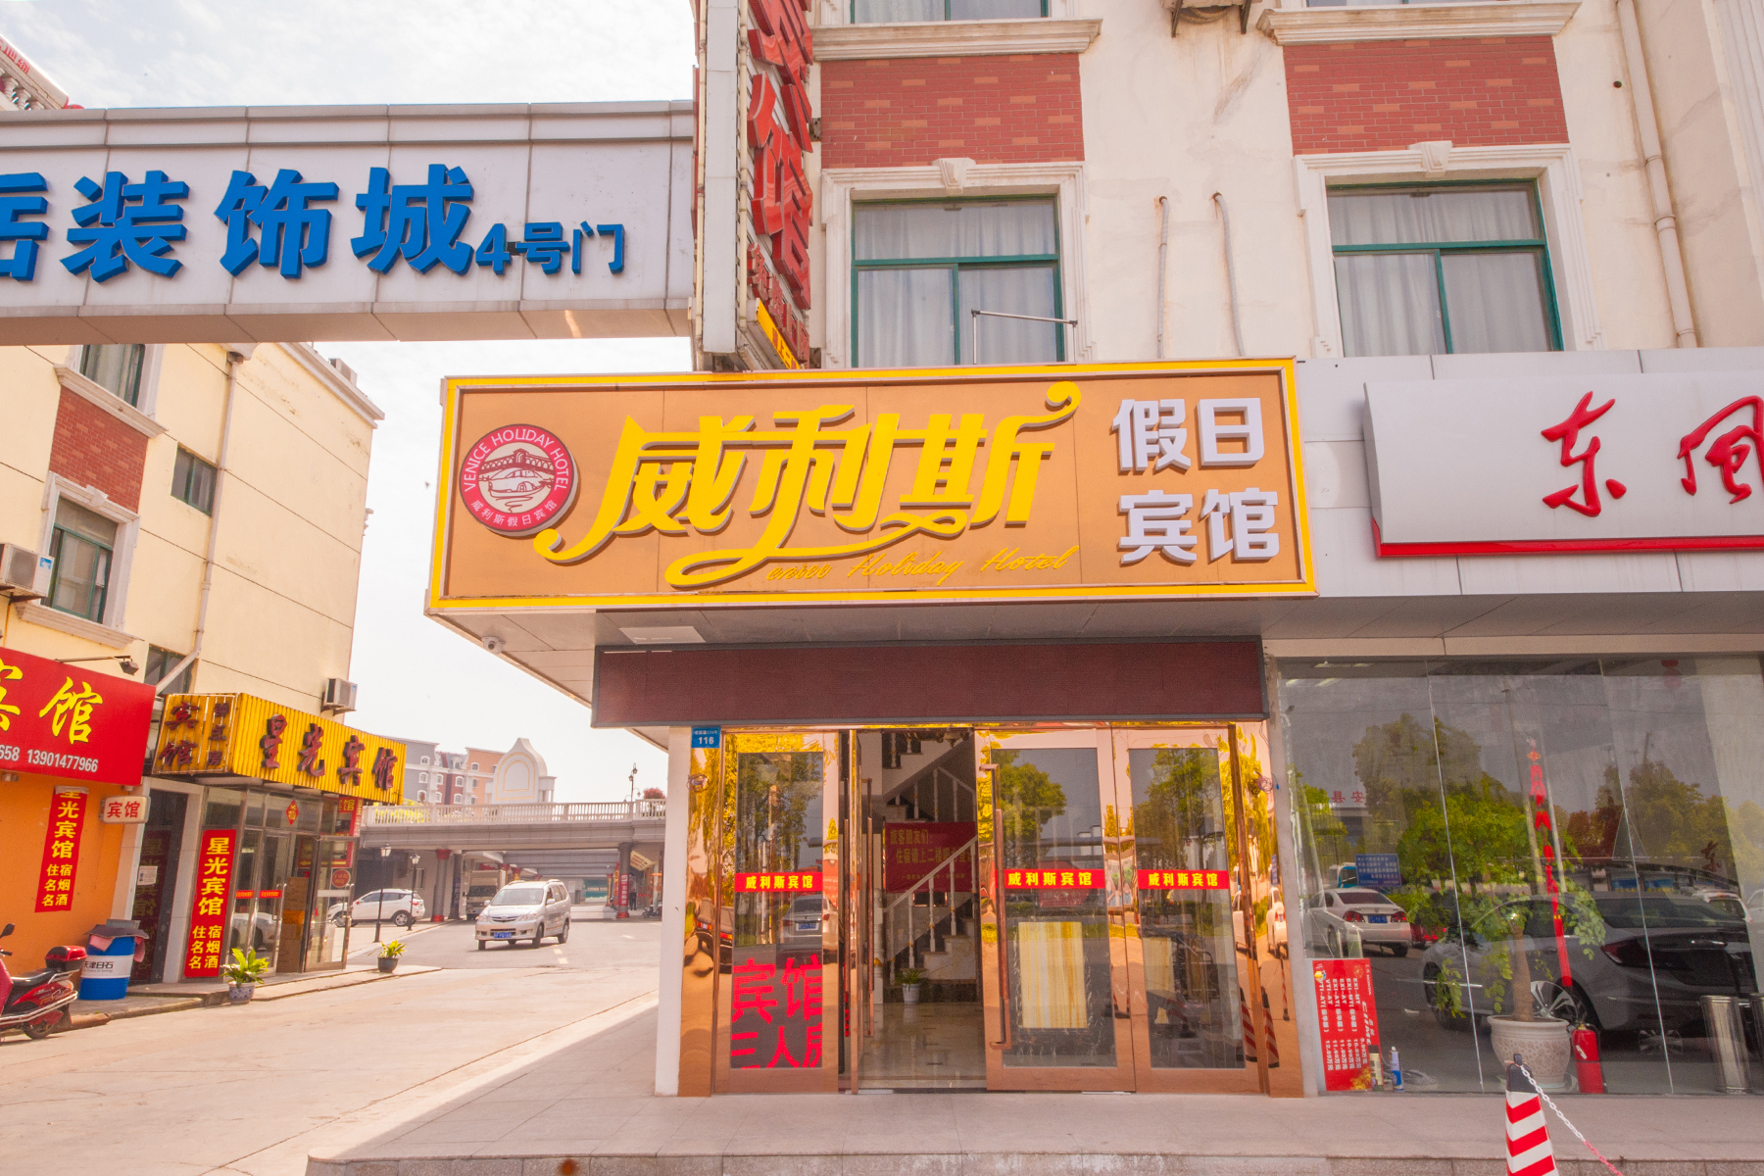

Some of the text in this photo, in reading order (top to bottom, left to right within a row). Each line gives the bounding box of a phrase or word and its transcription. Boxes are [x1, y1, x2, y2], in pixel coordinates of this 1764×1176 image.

[475, 219, 625, 275] 4号门
[1111, 397, 1264, 474] 假日
[464, 428, 569, 492] VENICE HOLIDAY HOTEL
[1541, 390, 1764, 517] 东风
[533, 381, 1080, 587] 威利斯
[1118, 487, 1280, 567] 宾馆
[847, 551, 964, 587] Holiday
[980, 545, 1080, 572] Hotel
[158, 701, 200, 767] 宾馆
[206, 702, 230, 767] 钟点房
[698, 736, 715, 745] 116
[27, 749, 99, 773] 13901477966
[259, 714, 398, 791] 星光宾馆
[107, 801, 141, 819] 宾馆
[44, 879, 71, 891] 名烟
[46, 863, 73, 876] 住宿
[198, 837, 230, 916] 星光宾馆
[745, 874, 813, 890] 威利斯宾馆
[1007, 871, 1092, 886] 威利斯宾馆
[1148, 873, 1218, 887] 威利斯宾馆
[42, 894, 69, 907] 名酒
[190, 940, 221, 954] 名烟
[192, 925, 222, 939] 住宿
[188, 955, 218, 969] 名酒
[732, 953, 823, 1024] 宾馆
